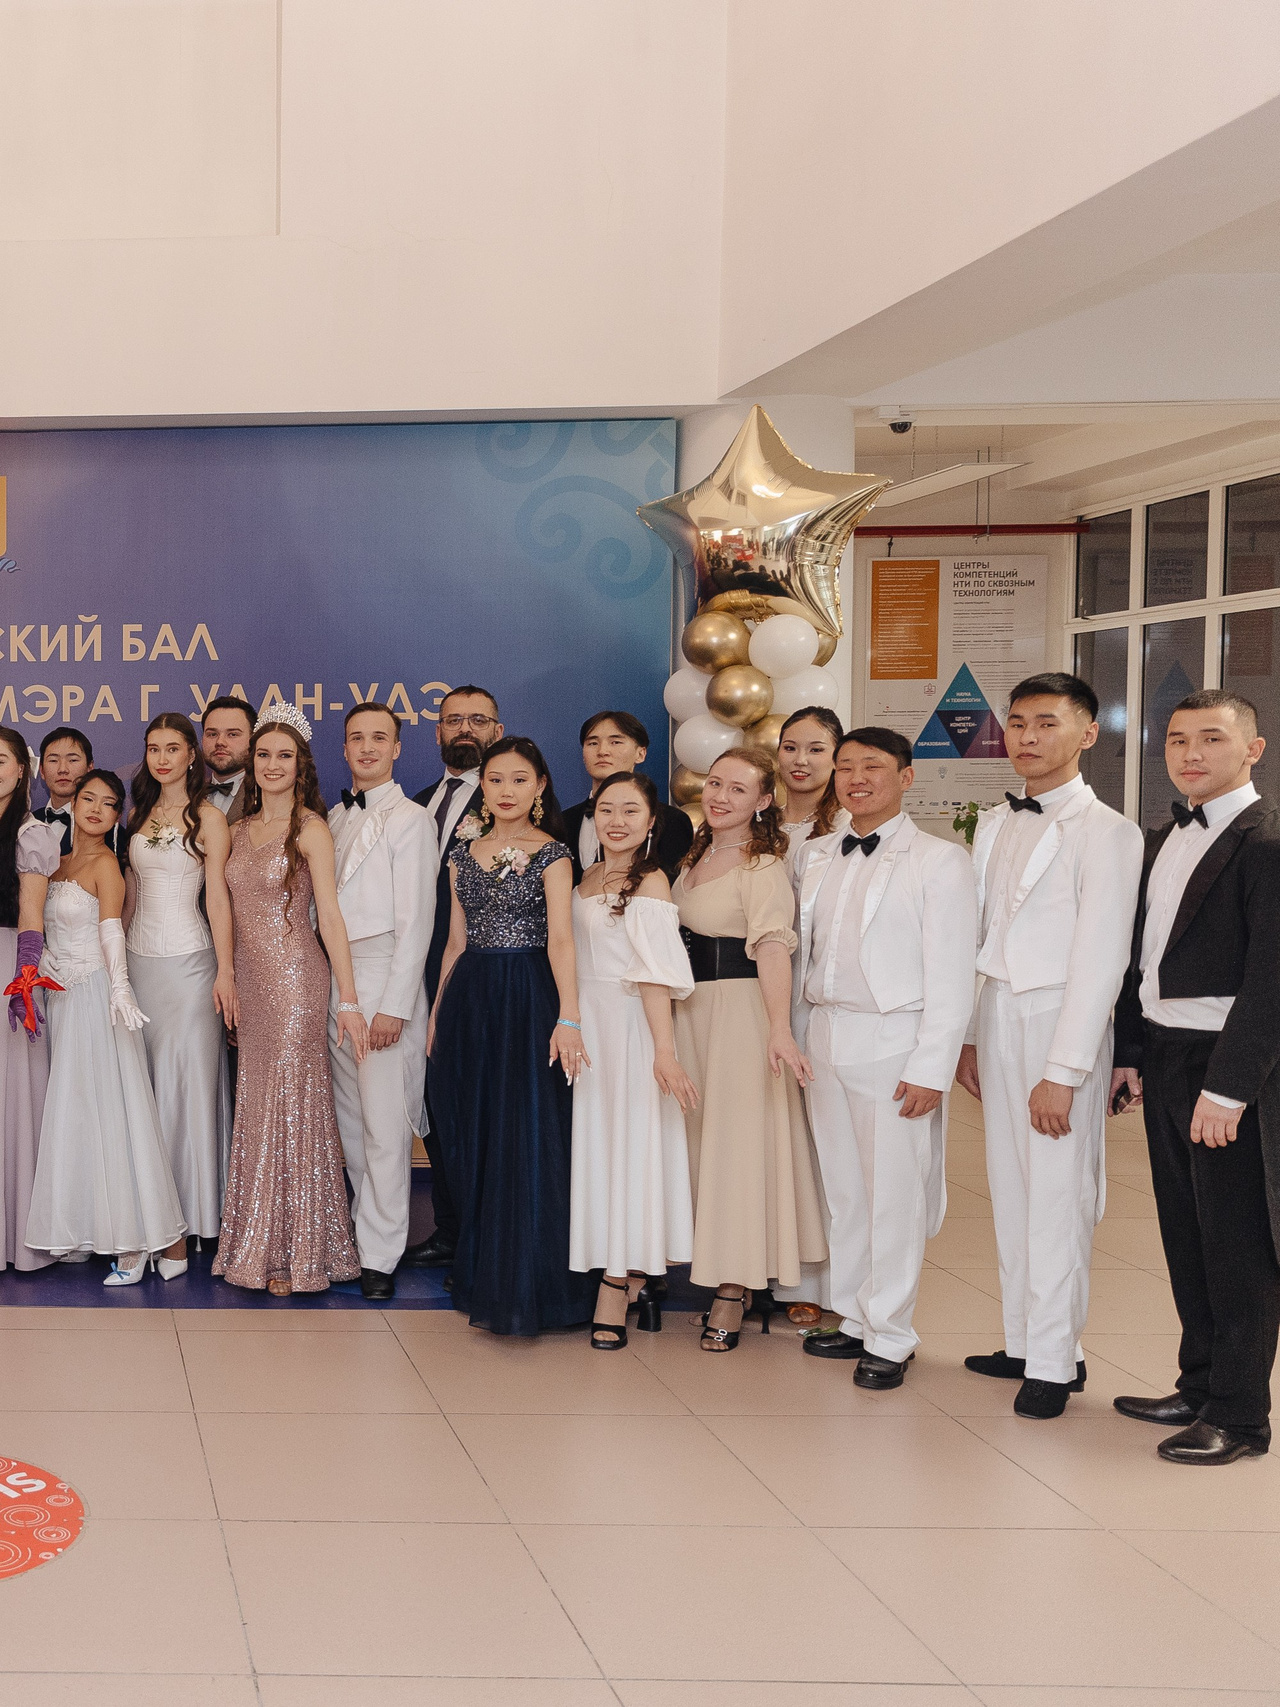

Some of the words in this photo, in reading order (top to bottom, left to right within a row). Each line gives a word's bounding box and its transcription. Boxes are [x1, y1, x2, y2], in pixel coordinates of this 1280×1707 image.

[953, 561, 990, 571] ЦЕНТРЫ
[953, 568, 1018, 579] КОМПЕТЕНЦИЙ
[953, 580, 971, 588] НТИ
[973, 580, 986, 588] ПО
[988, 579, 1036, 588] СКВОЗНЫМ
[952, 589, 1015, 598] ТЕХНОЛОГИЯМ
[122, 623, 220, 662] БАЛ
